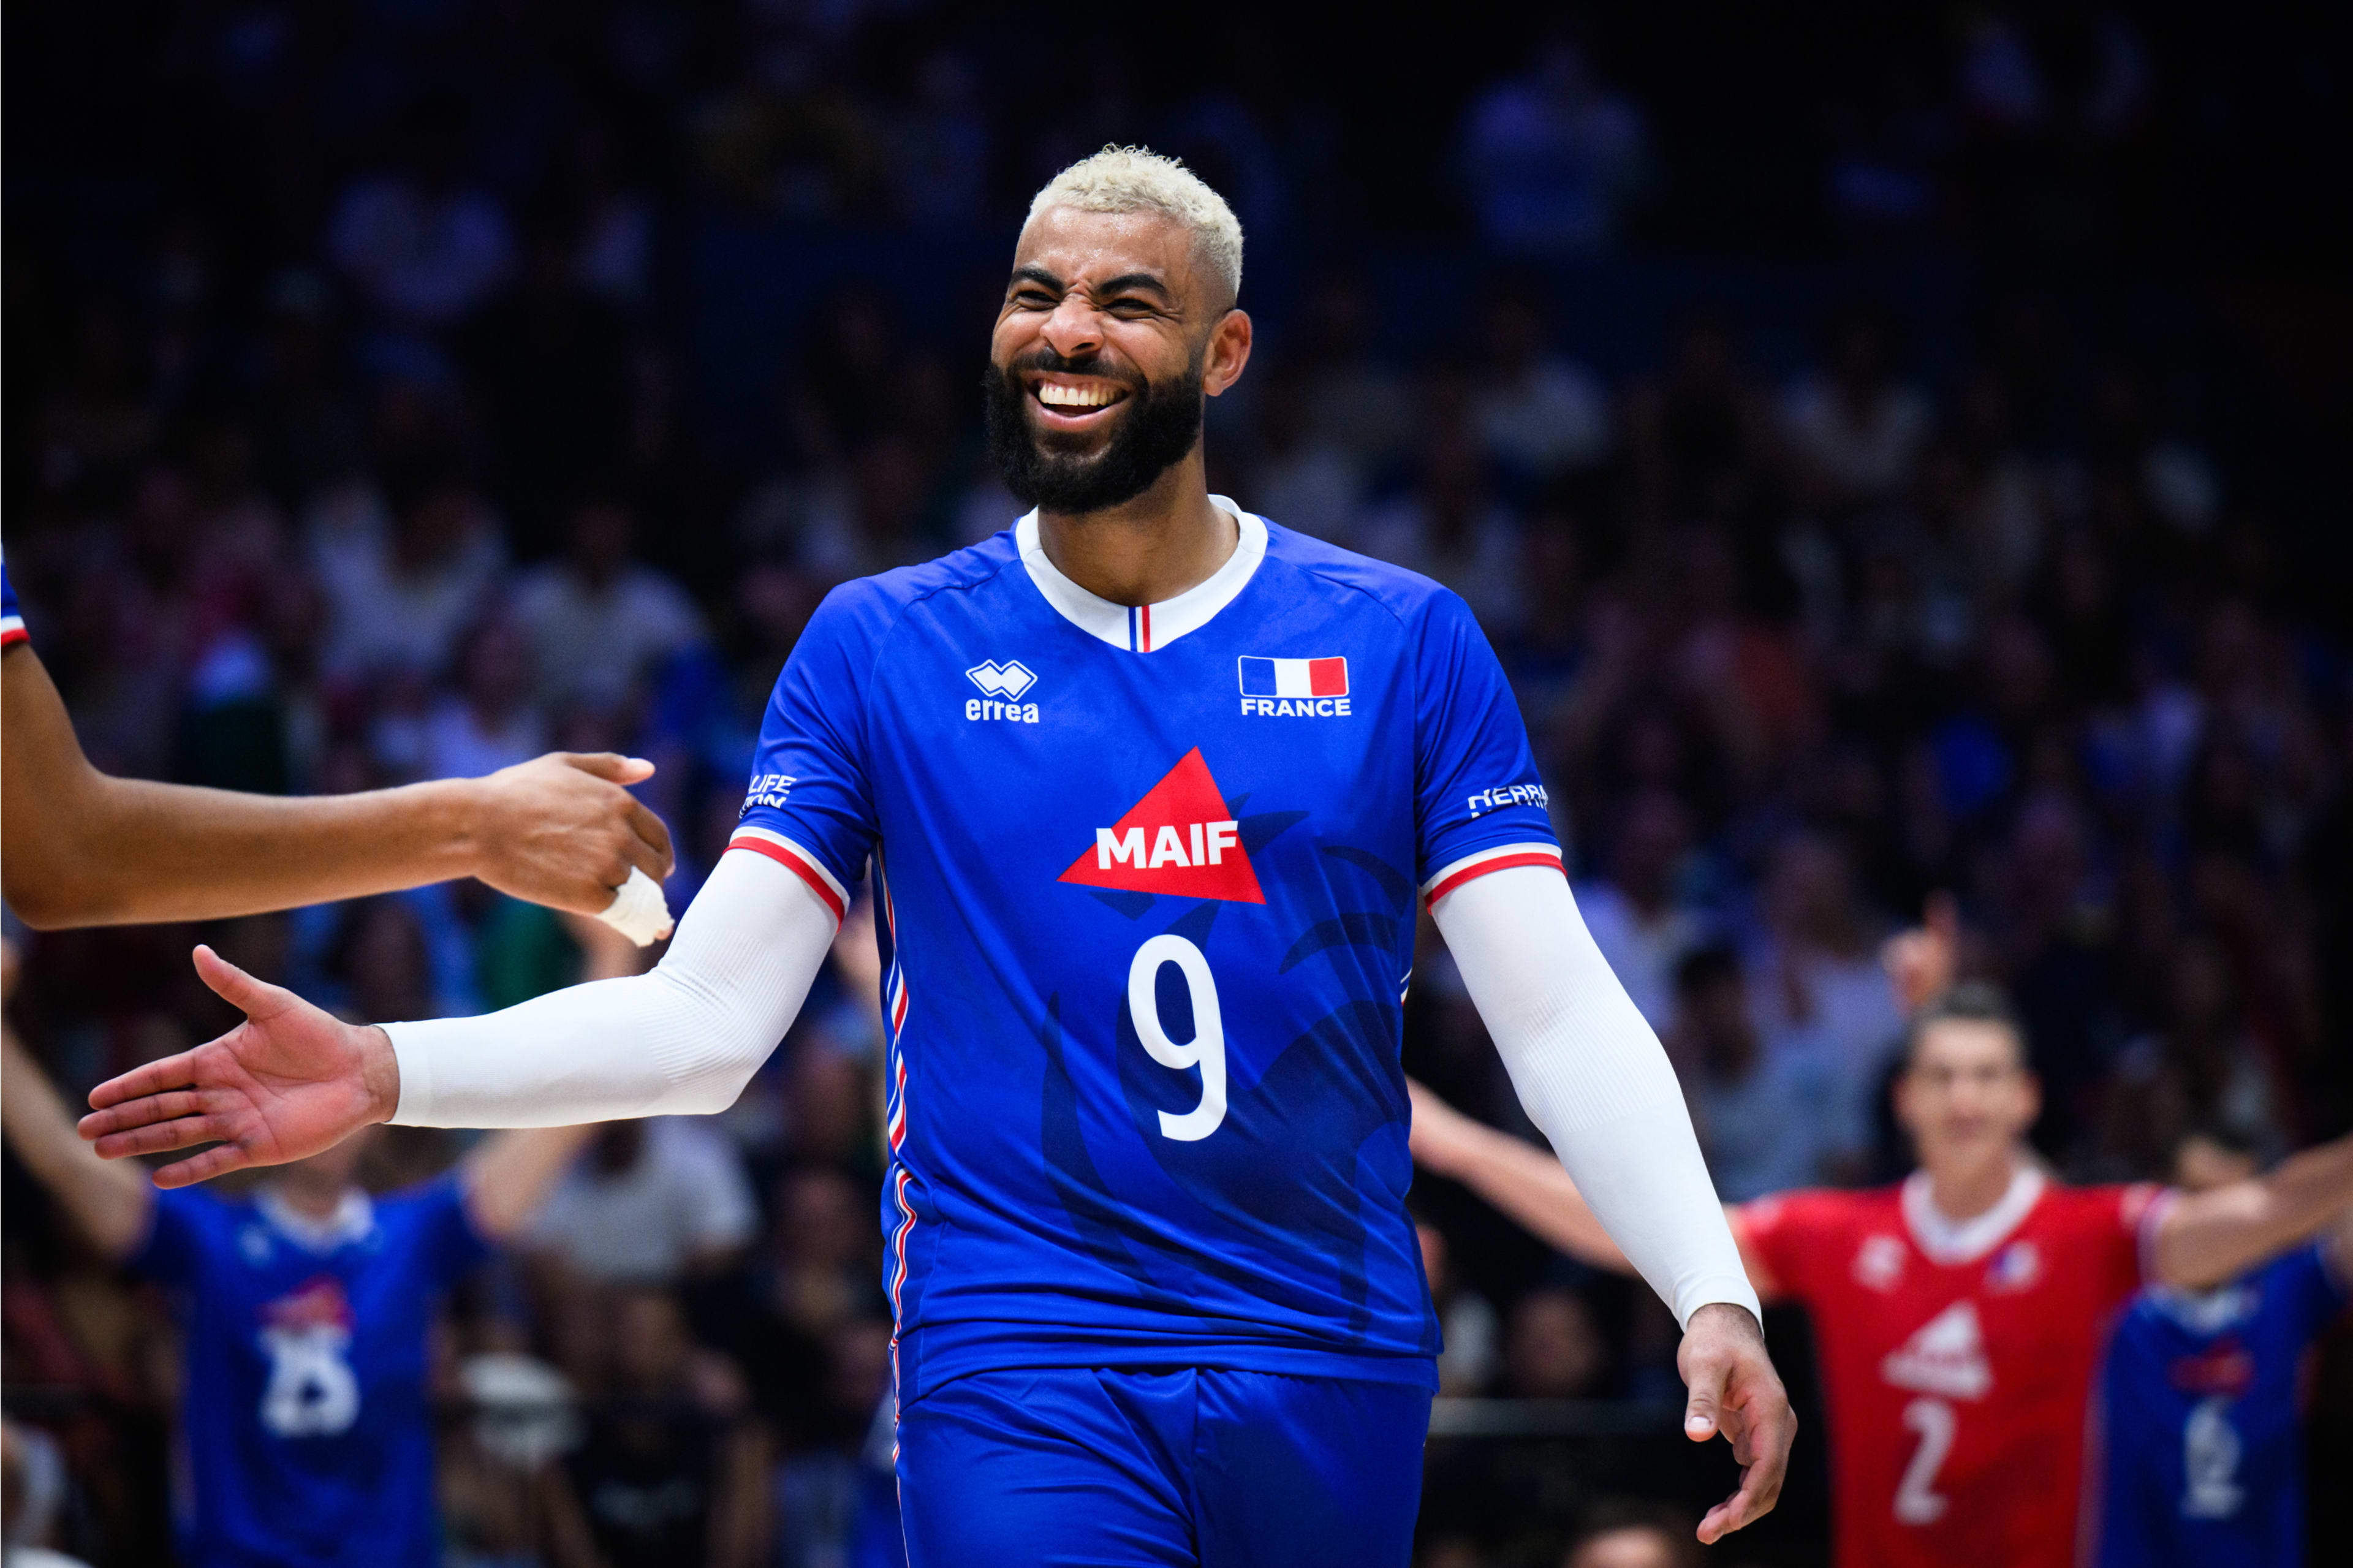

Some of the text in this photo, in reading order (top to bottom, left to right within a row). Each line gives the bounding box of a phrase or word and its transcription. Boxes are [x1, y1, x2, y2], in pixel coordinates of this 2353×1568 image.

[1240, 699, 1352, 717] FRANCE
[1096, 820, 1238, 869] MAIF
[1128, 934, 1227, 1142] 9
[1893, 1396, 1955, 1524] 2
